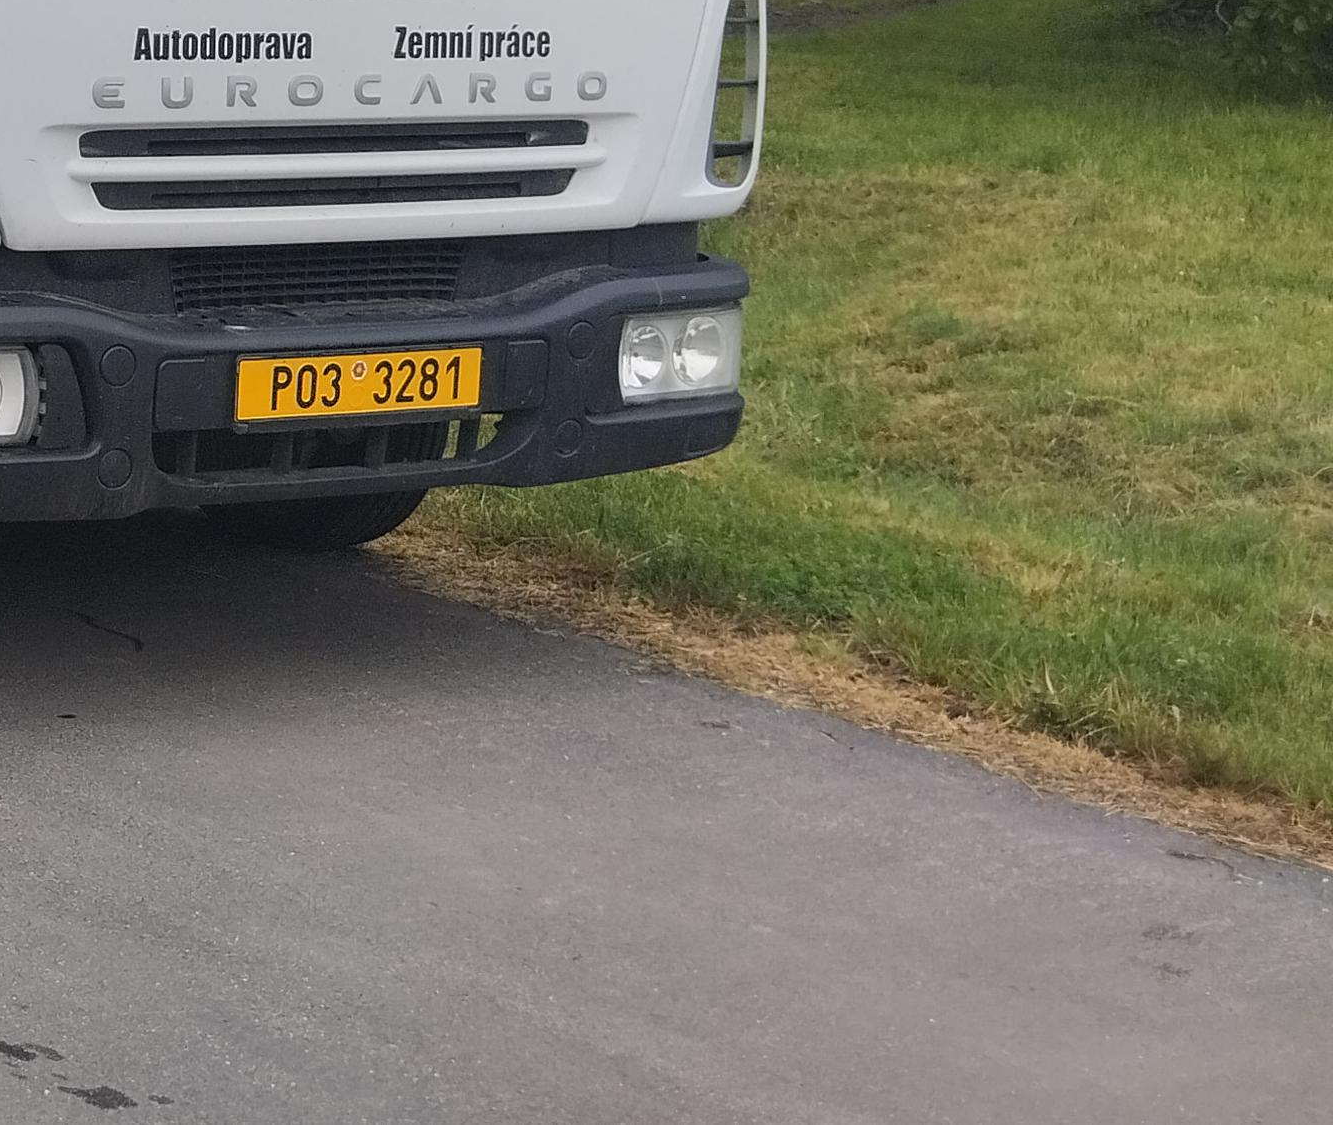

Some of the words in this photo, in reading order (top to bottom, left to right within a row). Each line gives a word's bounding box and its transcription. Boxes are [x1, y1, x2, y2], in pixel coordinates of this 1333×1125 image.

[133, 27, 312, 63] Autodoprava
[393, 24, 473, 58] Zemní
[479, 24, 550, 61] práce
[91, 71, 608, 109] EUROCARGO
[271, 364, 342, 411] P03
[373, 356, 461, 404] 3281
